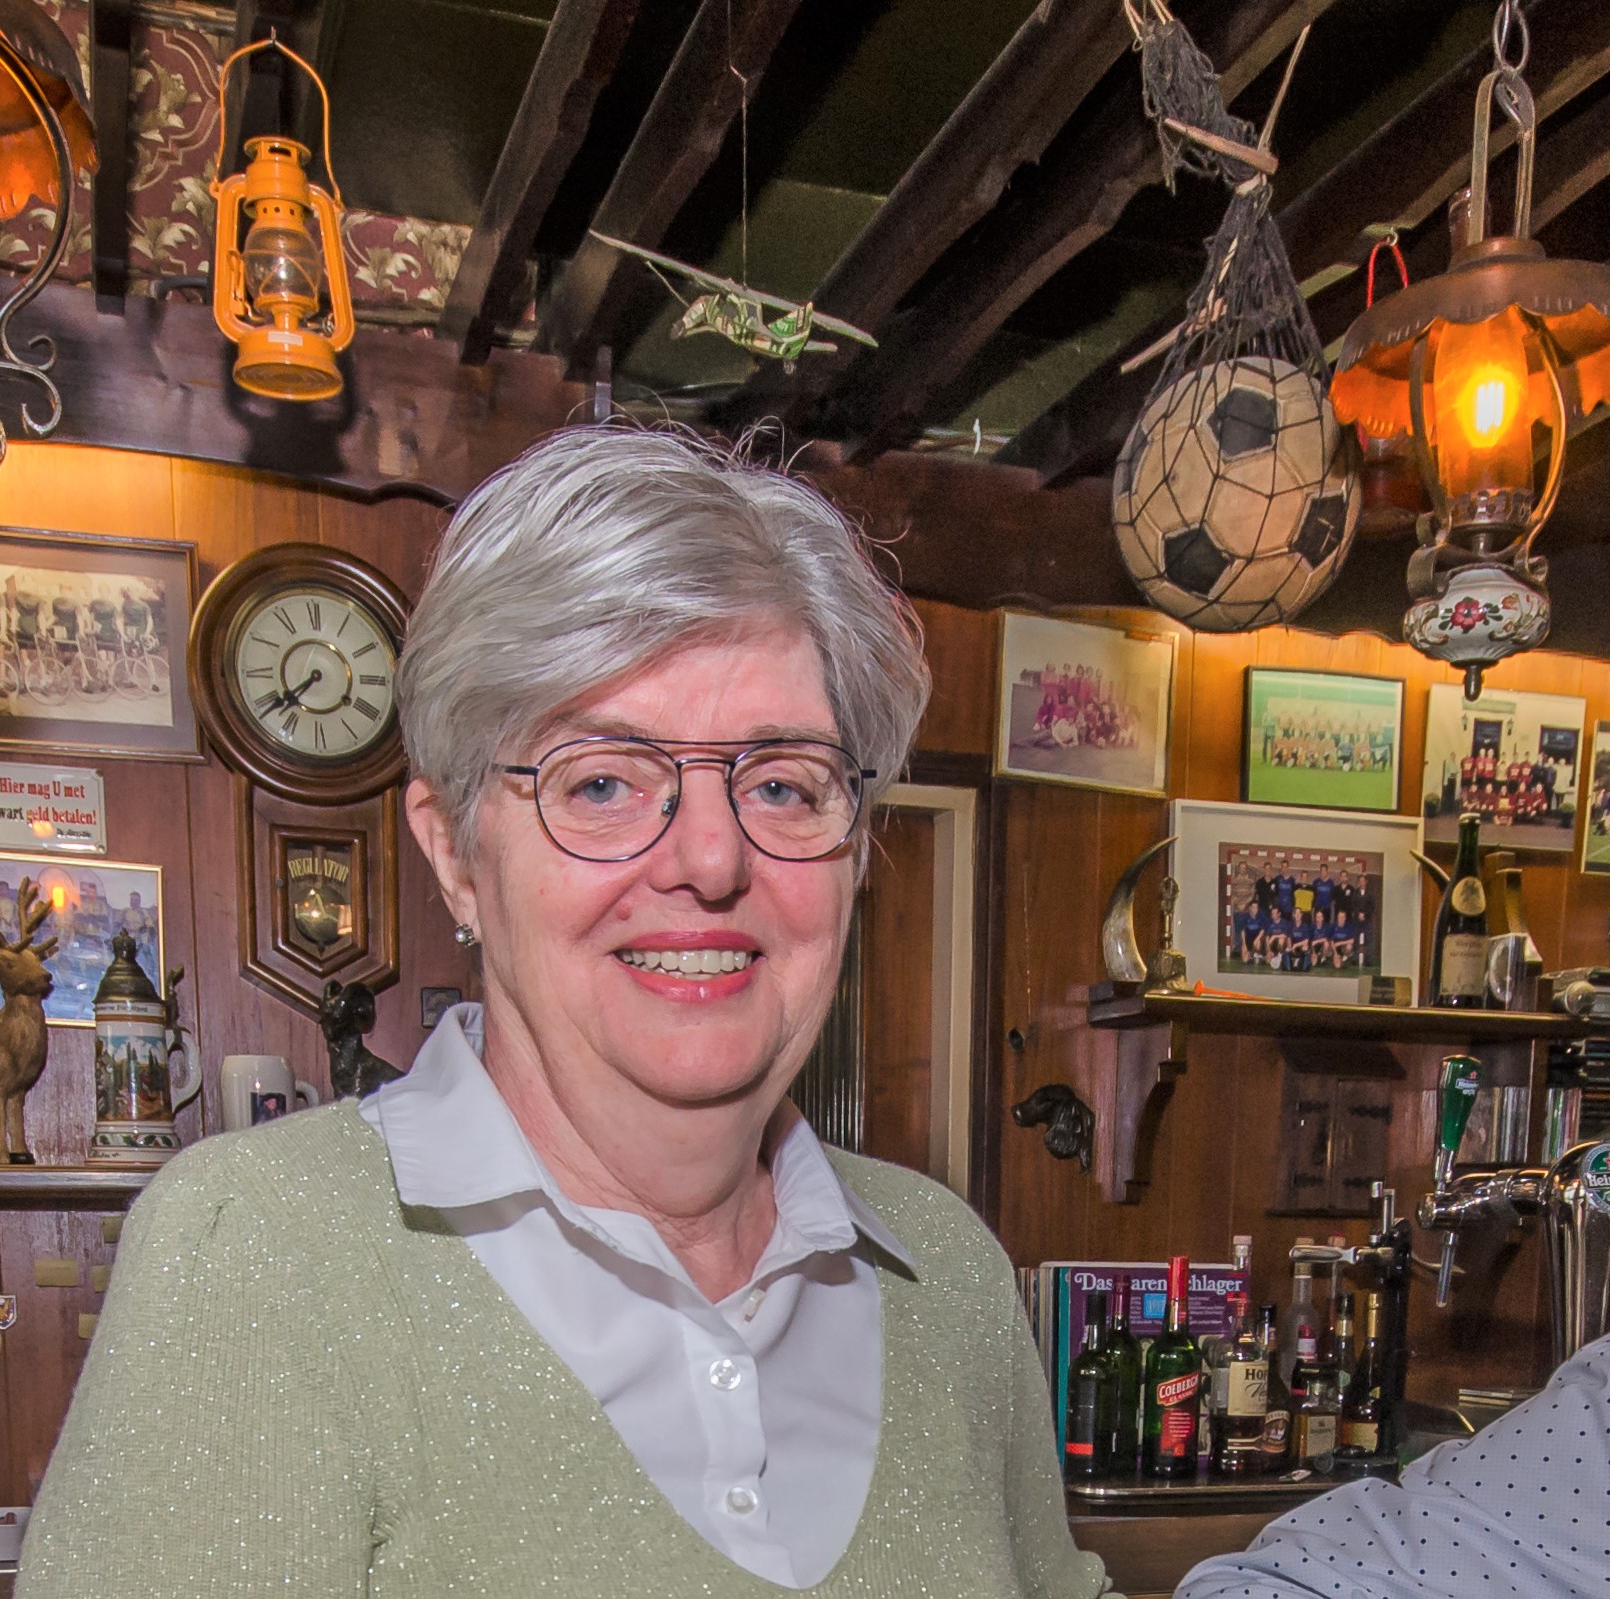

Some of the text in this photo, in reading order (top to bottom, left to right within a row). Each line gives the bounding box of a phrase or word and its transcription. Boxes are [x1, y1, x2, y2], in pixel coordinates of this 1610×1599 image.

[0, 777, 85, 800] Hier mag U met
[26, 806, 50, 824] geld
[52, 807, 97, 825] betalen!
[1074, 1272, 1113, 1291] Das
[1131, 1278, 1168, 1291] aren
